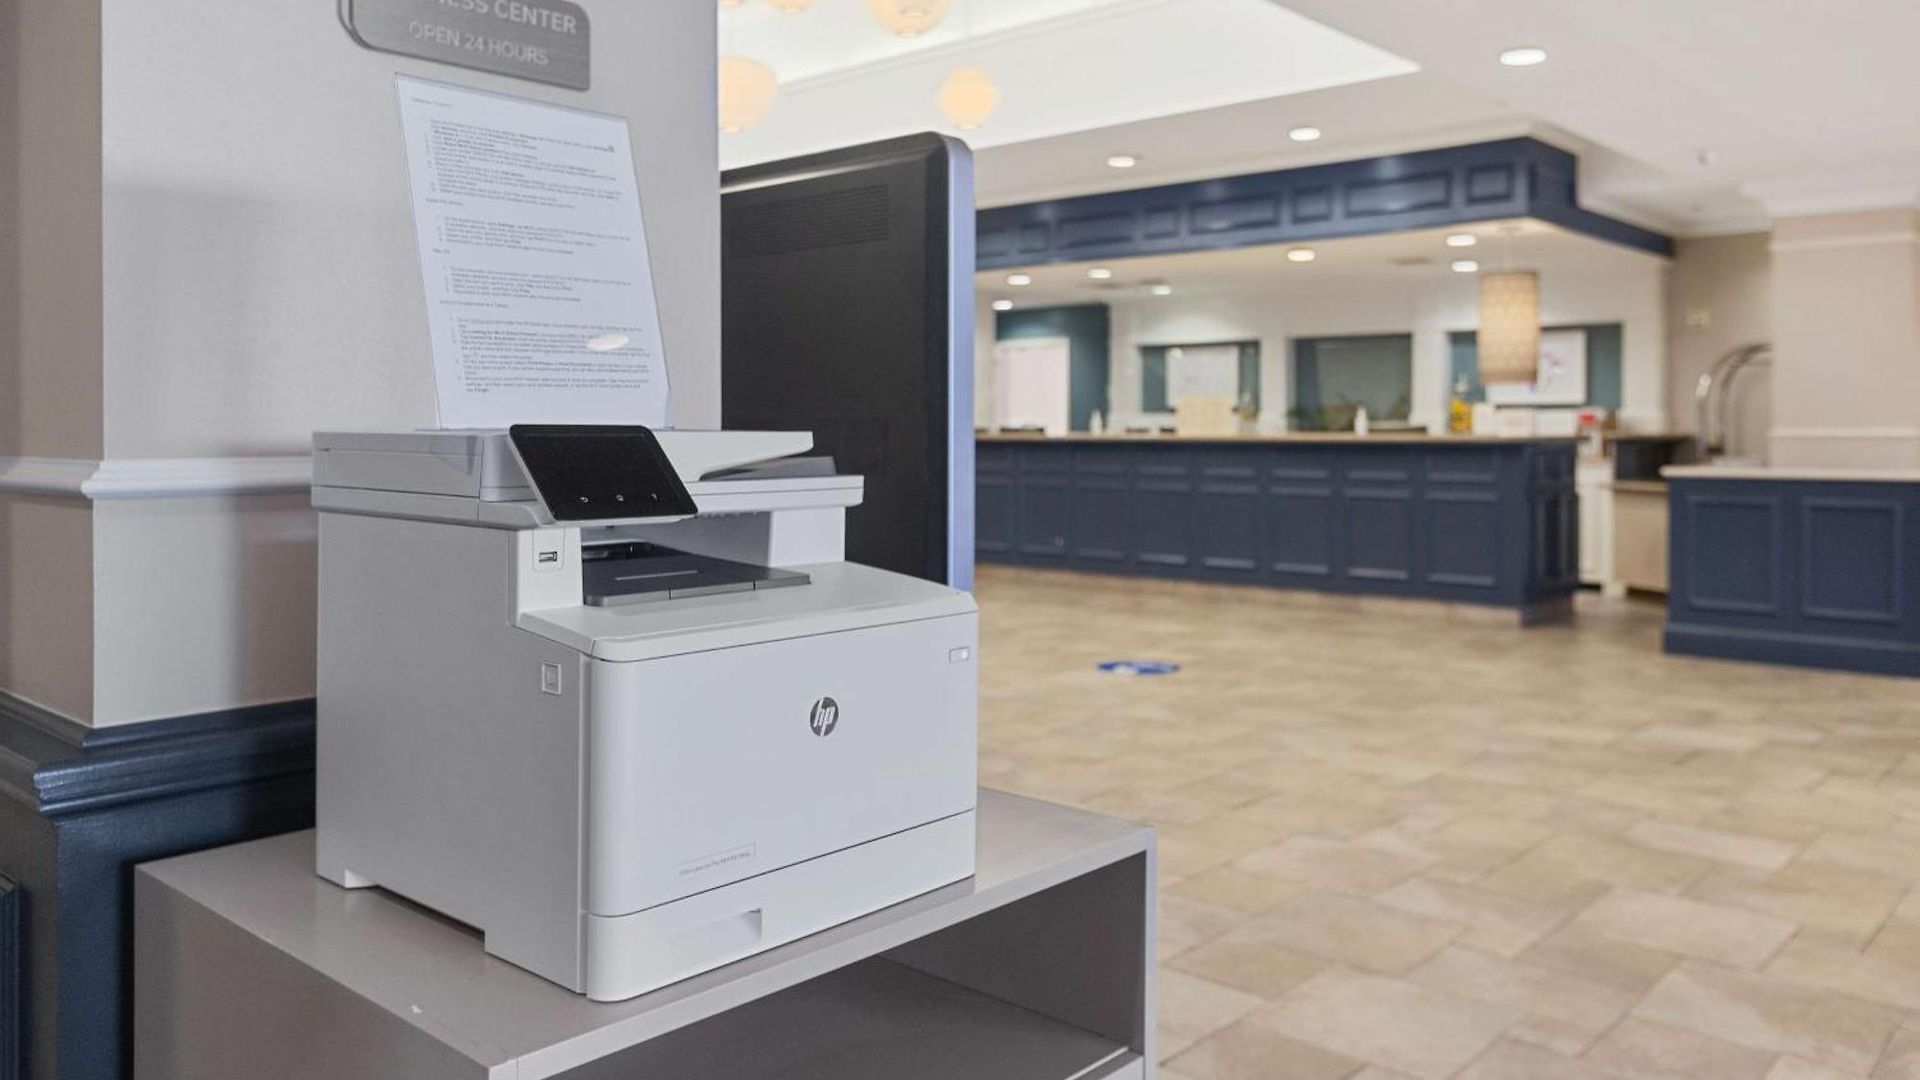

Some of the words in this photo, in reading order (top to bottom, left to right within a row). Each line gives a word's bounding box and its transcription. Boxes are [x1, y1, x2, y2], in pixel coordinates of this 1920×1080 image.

[494, 0, 577, 35] CENTER
[409, 21, 460, 47] OPEN
[465, 34, 484, 51] 24
[488, 39, 549, 66] HOURS
[811, 697, 838, 737] hp
